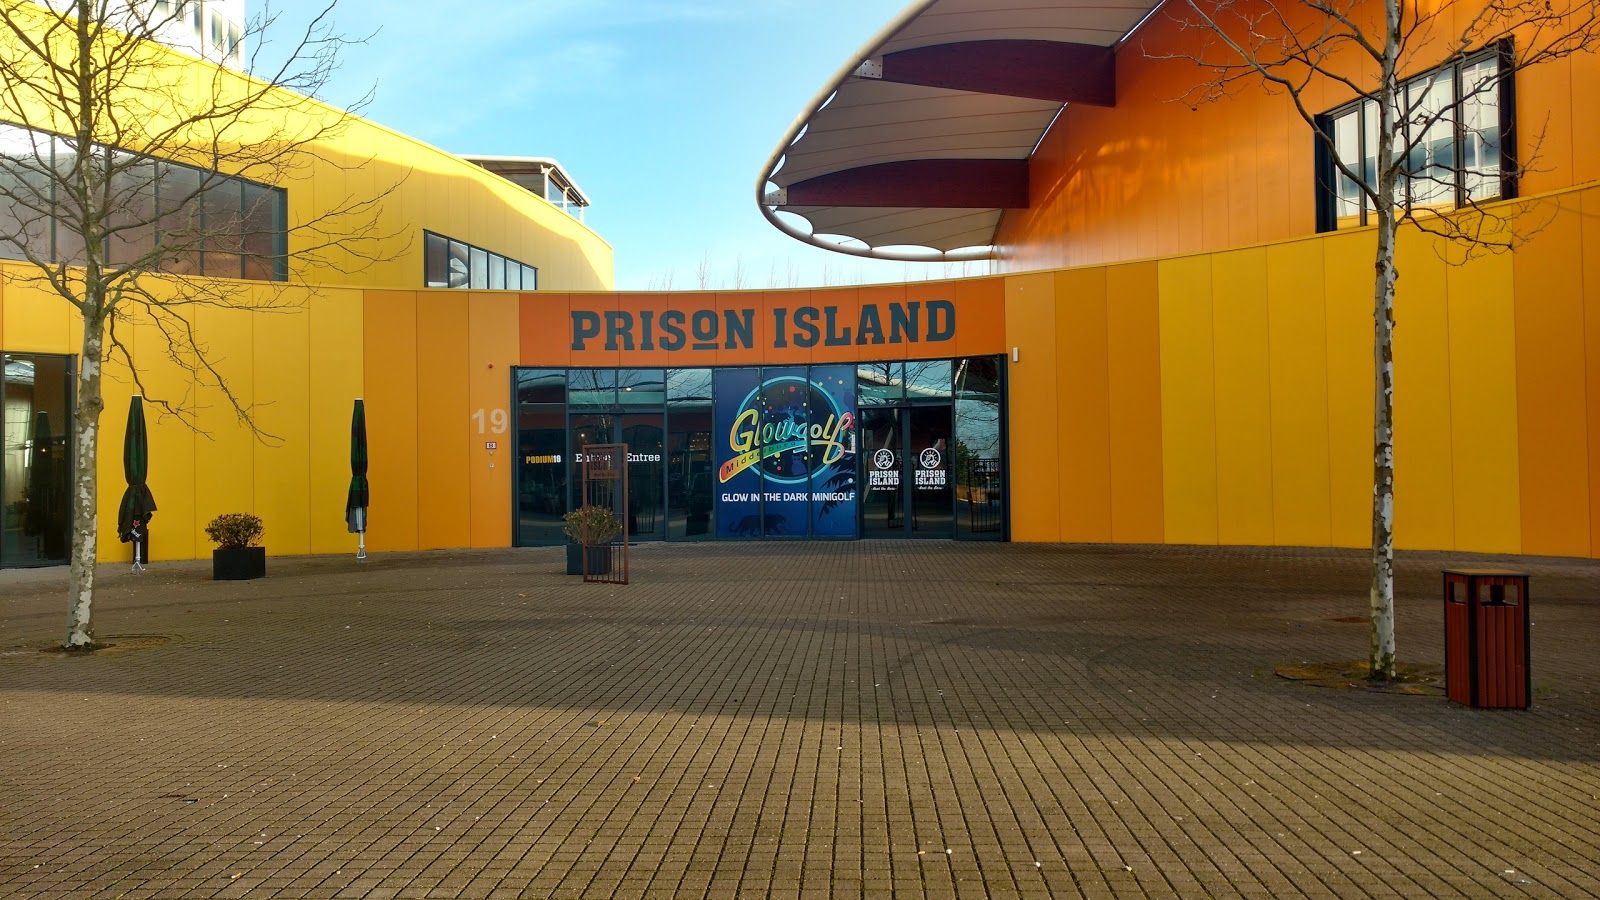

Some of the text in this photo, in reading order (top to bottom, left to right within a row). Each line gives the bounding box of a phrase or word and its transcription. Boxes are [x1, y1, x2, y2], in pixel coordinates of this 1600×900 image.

[570, 299, 956, 351] PRISON ISLAND
[471, 408, 508, 434] 19
[729, 408, 854, 465] Glowgolf
[526, 455, 561, 464] PODIUM19
[626, 452, 661, 462] Entree
[869, 470, 899, 478] PRISON
[915, 470, 946, 478] PRISON
[869, 477, 899, 486] ISLAND
[915, 477, 946, 485] ISLAND
[721, 491, 856, 502] GLOW IN THE DARK MINIGOLF
